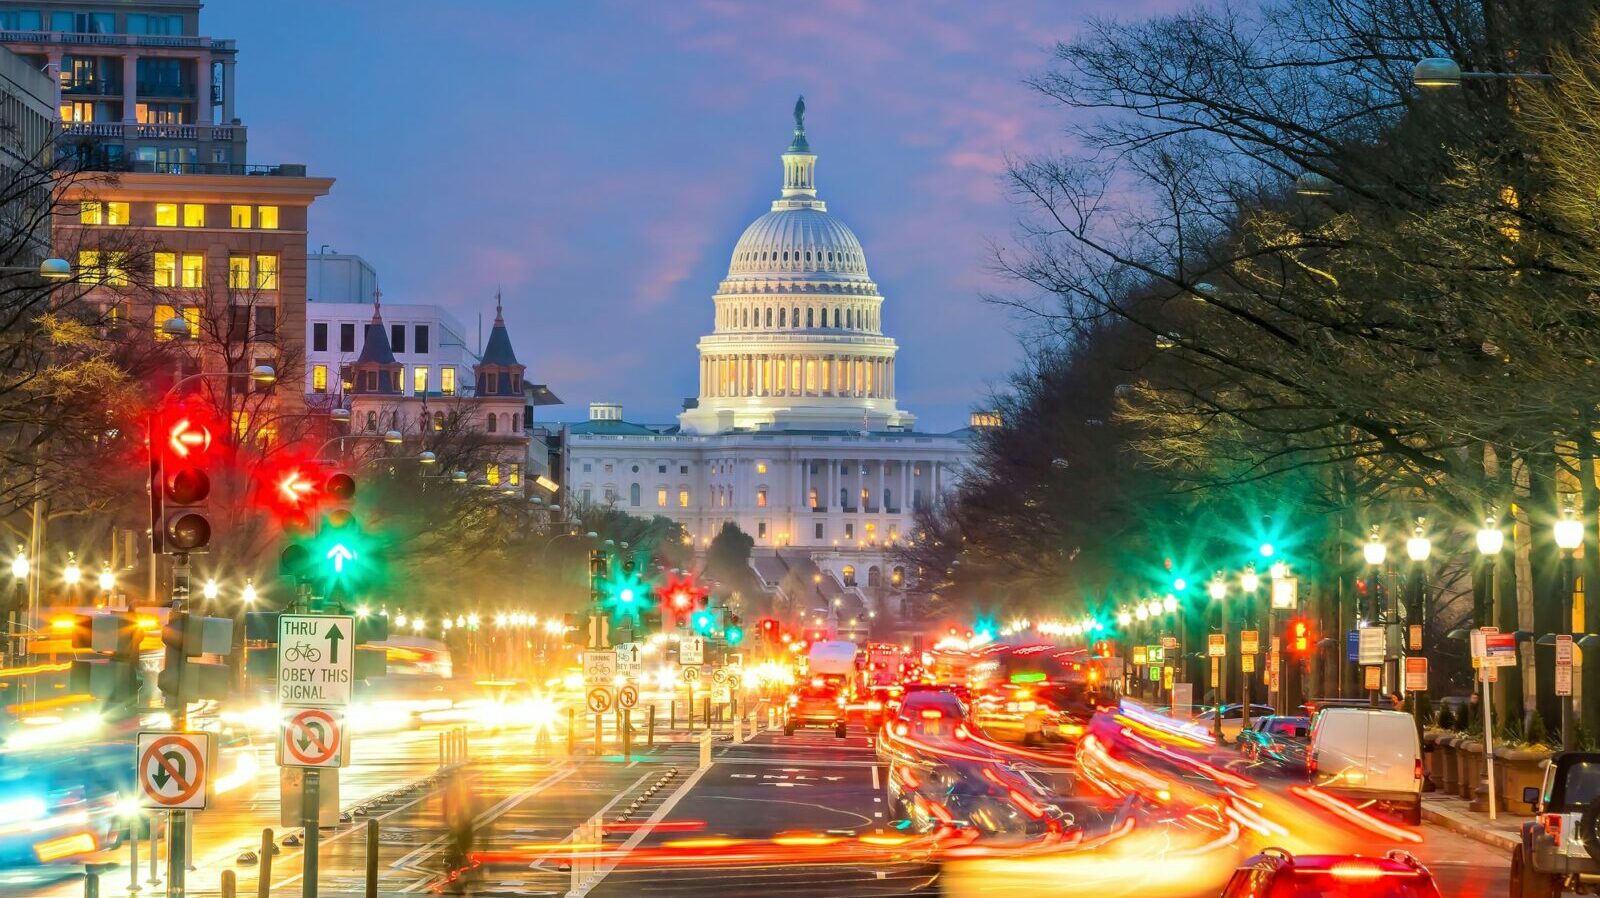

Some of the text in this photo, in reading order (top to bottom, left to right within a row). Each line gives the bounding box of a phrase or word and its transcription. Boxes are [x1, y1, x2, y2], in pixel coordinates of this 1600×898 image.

[284, 621, 318, 636] THRU
[282, 668, 349, 683] OBEY THIS
[281, 685, 327, 699] SIGNAL
